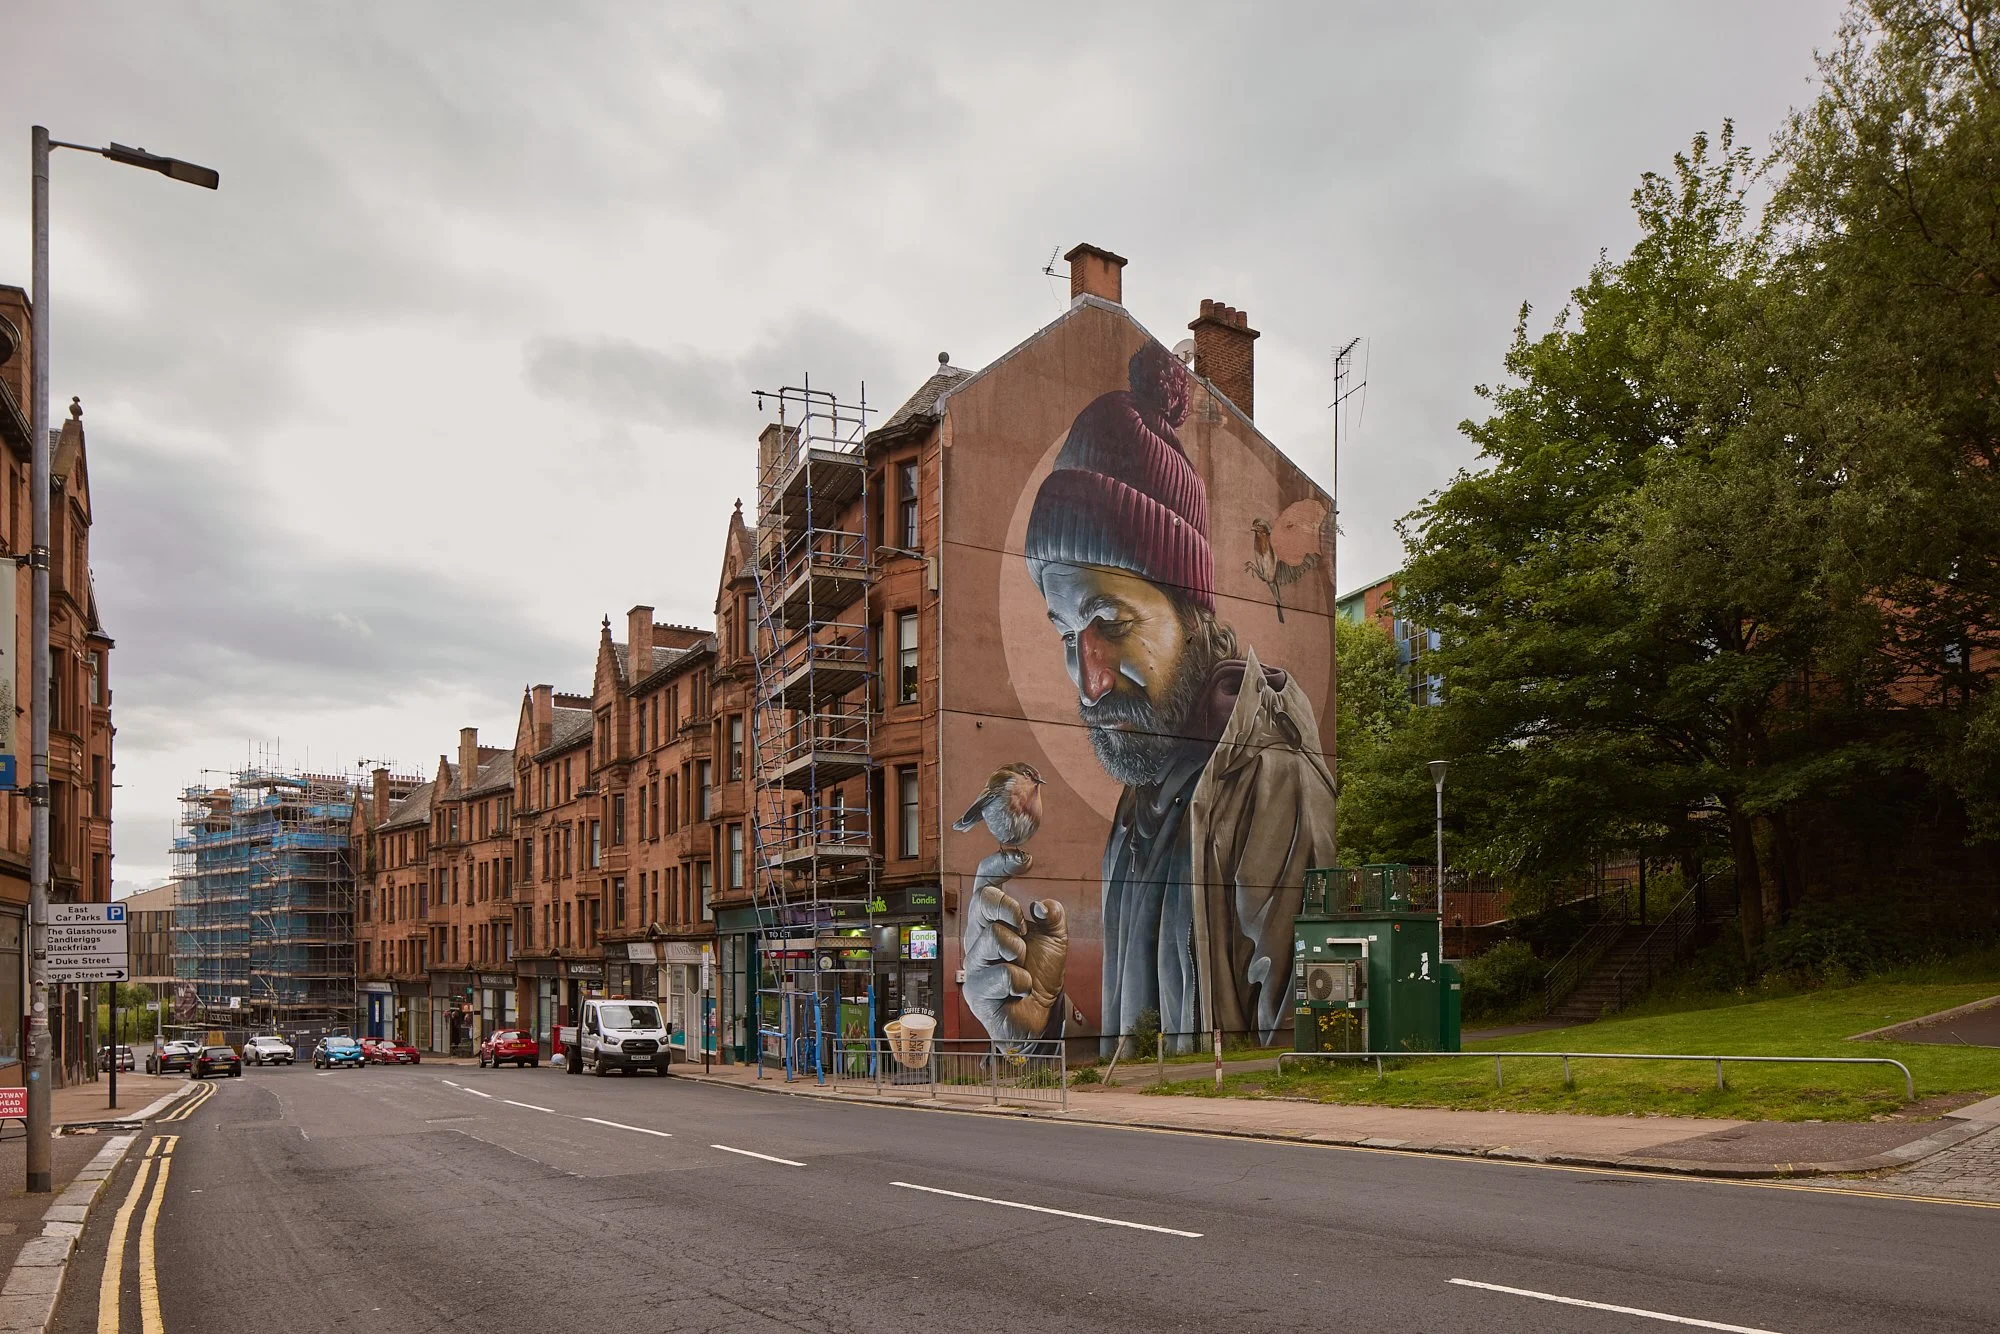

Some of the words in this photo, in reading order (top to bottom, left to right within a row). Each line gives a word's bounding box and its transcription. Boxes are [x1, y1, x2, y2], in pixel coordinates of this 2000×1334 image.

[864, 896, 887, 913] Lndis
[911, 896, 937, 905] Londis
[111, 907, 121, 919] P
[48, 936, 101, 944] Candleriggs
[911, 932, 936, 940] Londis
[48, 944, 97, 952] Blackfriars
